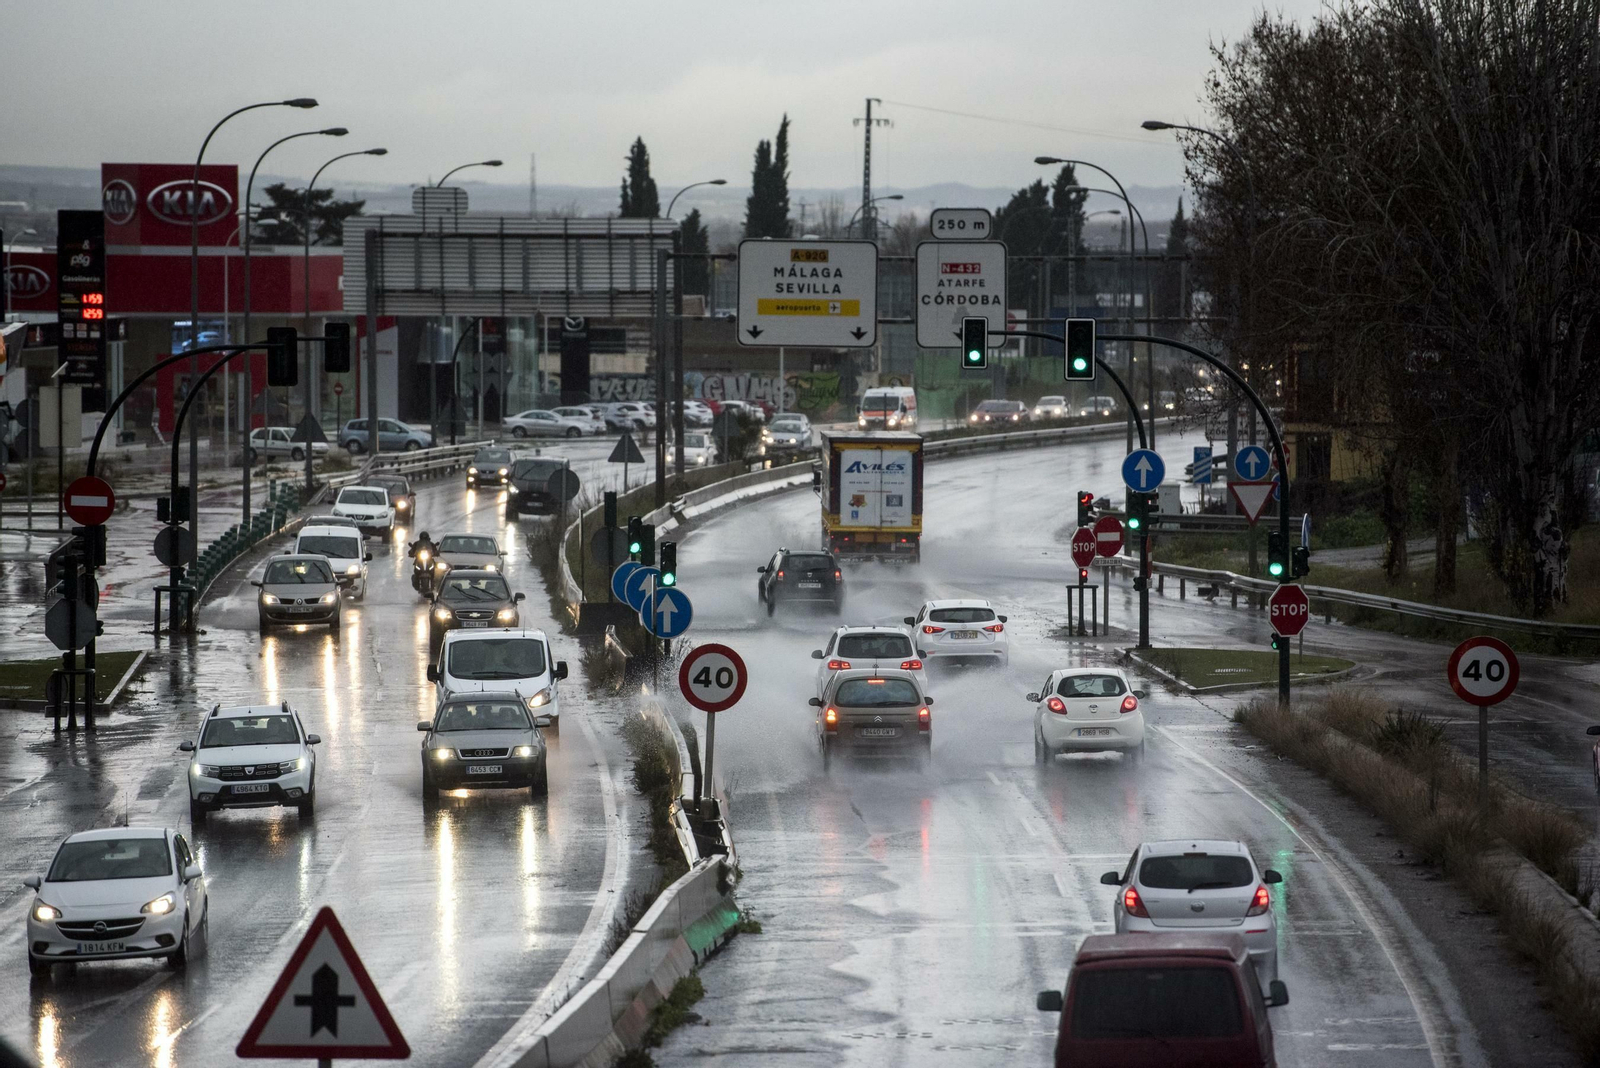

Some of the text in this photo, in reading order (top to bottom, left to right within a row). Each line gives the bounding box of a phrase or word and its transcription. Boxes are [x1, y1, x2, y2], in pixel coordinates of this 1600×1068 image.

[105, 189, 129, 214] KIA
[162, 190, 218, 215] KIA
[938, 220, 985, 230] 250 m
[773, 263, 843, 278] MÁLAGA
[942, 264, 981, 273] N-432
[775, 282, 842, 294] SEVILLA
[937, 278, 986, 287] ATARFE
[921, 291, 1001, 305] CÓRDOBA
[776, 304, 821, 312] aeropuerto
[1073, 542, 1095, 552] STOP
[1271, 603, 1307, 617] STOP
[1462, 659, 1505, 682] 40
[692, 666, 734, 689] 40
[84, 942, 124, 952] 1814 KFM
